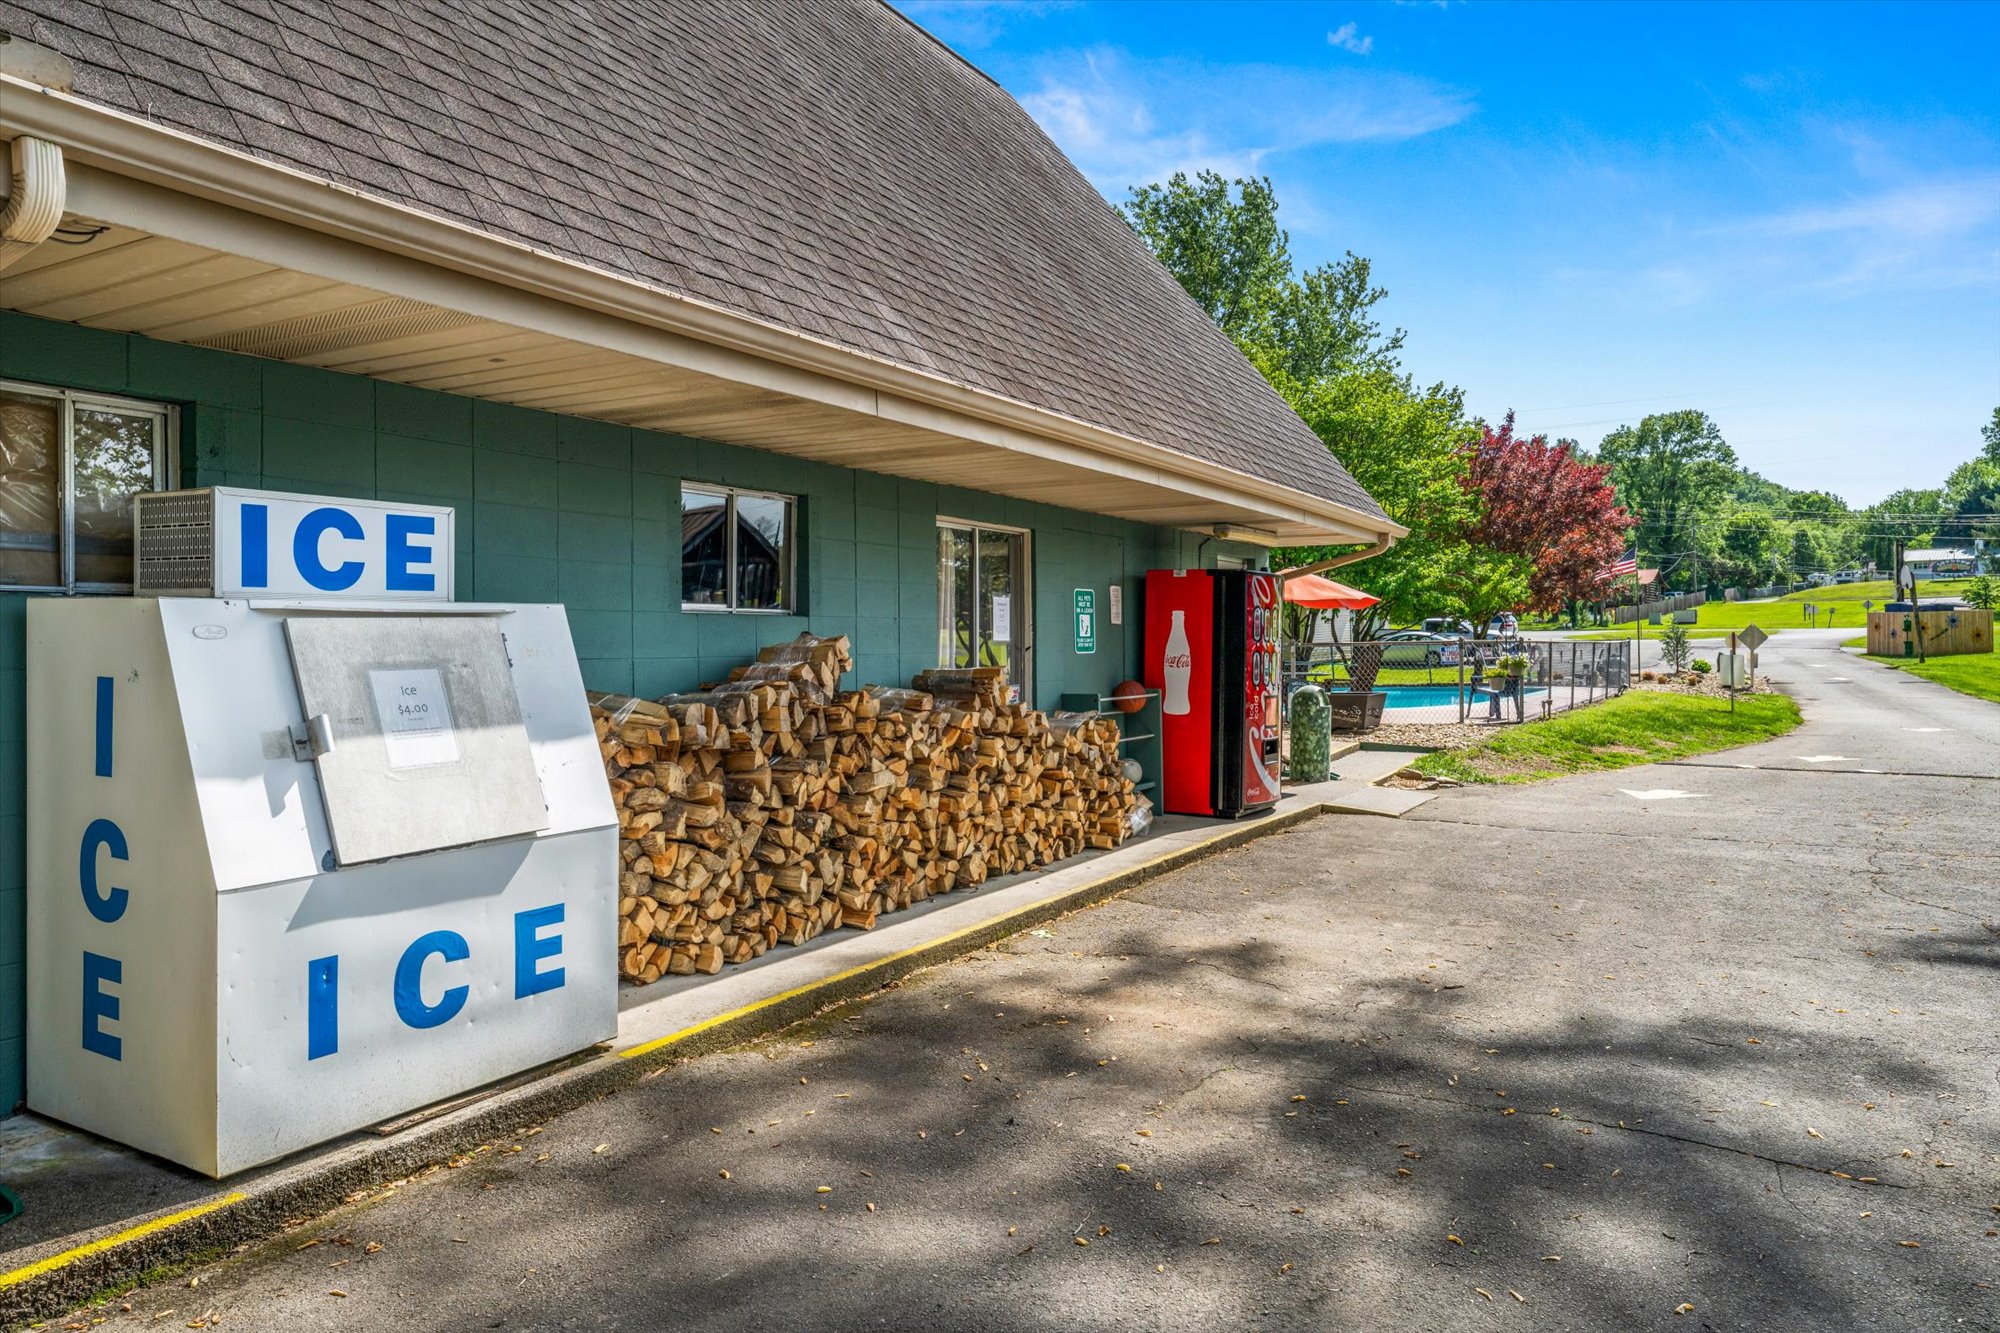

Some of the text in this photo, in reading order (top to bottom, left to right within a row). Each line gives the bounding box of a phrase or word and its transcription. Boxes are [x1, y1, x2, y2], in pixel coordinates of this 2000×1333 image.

[240, 503, 437, 593] ICE
[1165, 653, 1190, 669] oca-Cola
[397, 704, 429, 716] $4.00
[400, 686, 418, 696] Ice
[79, 676, 129, 1061] ICE
[307, 902, 566, 1061] ICE
